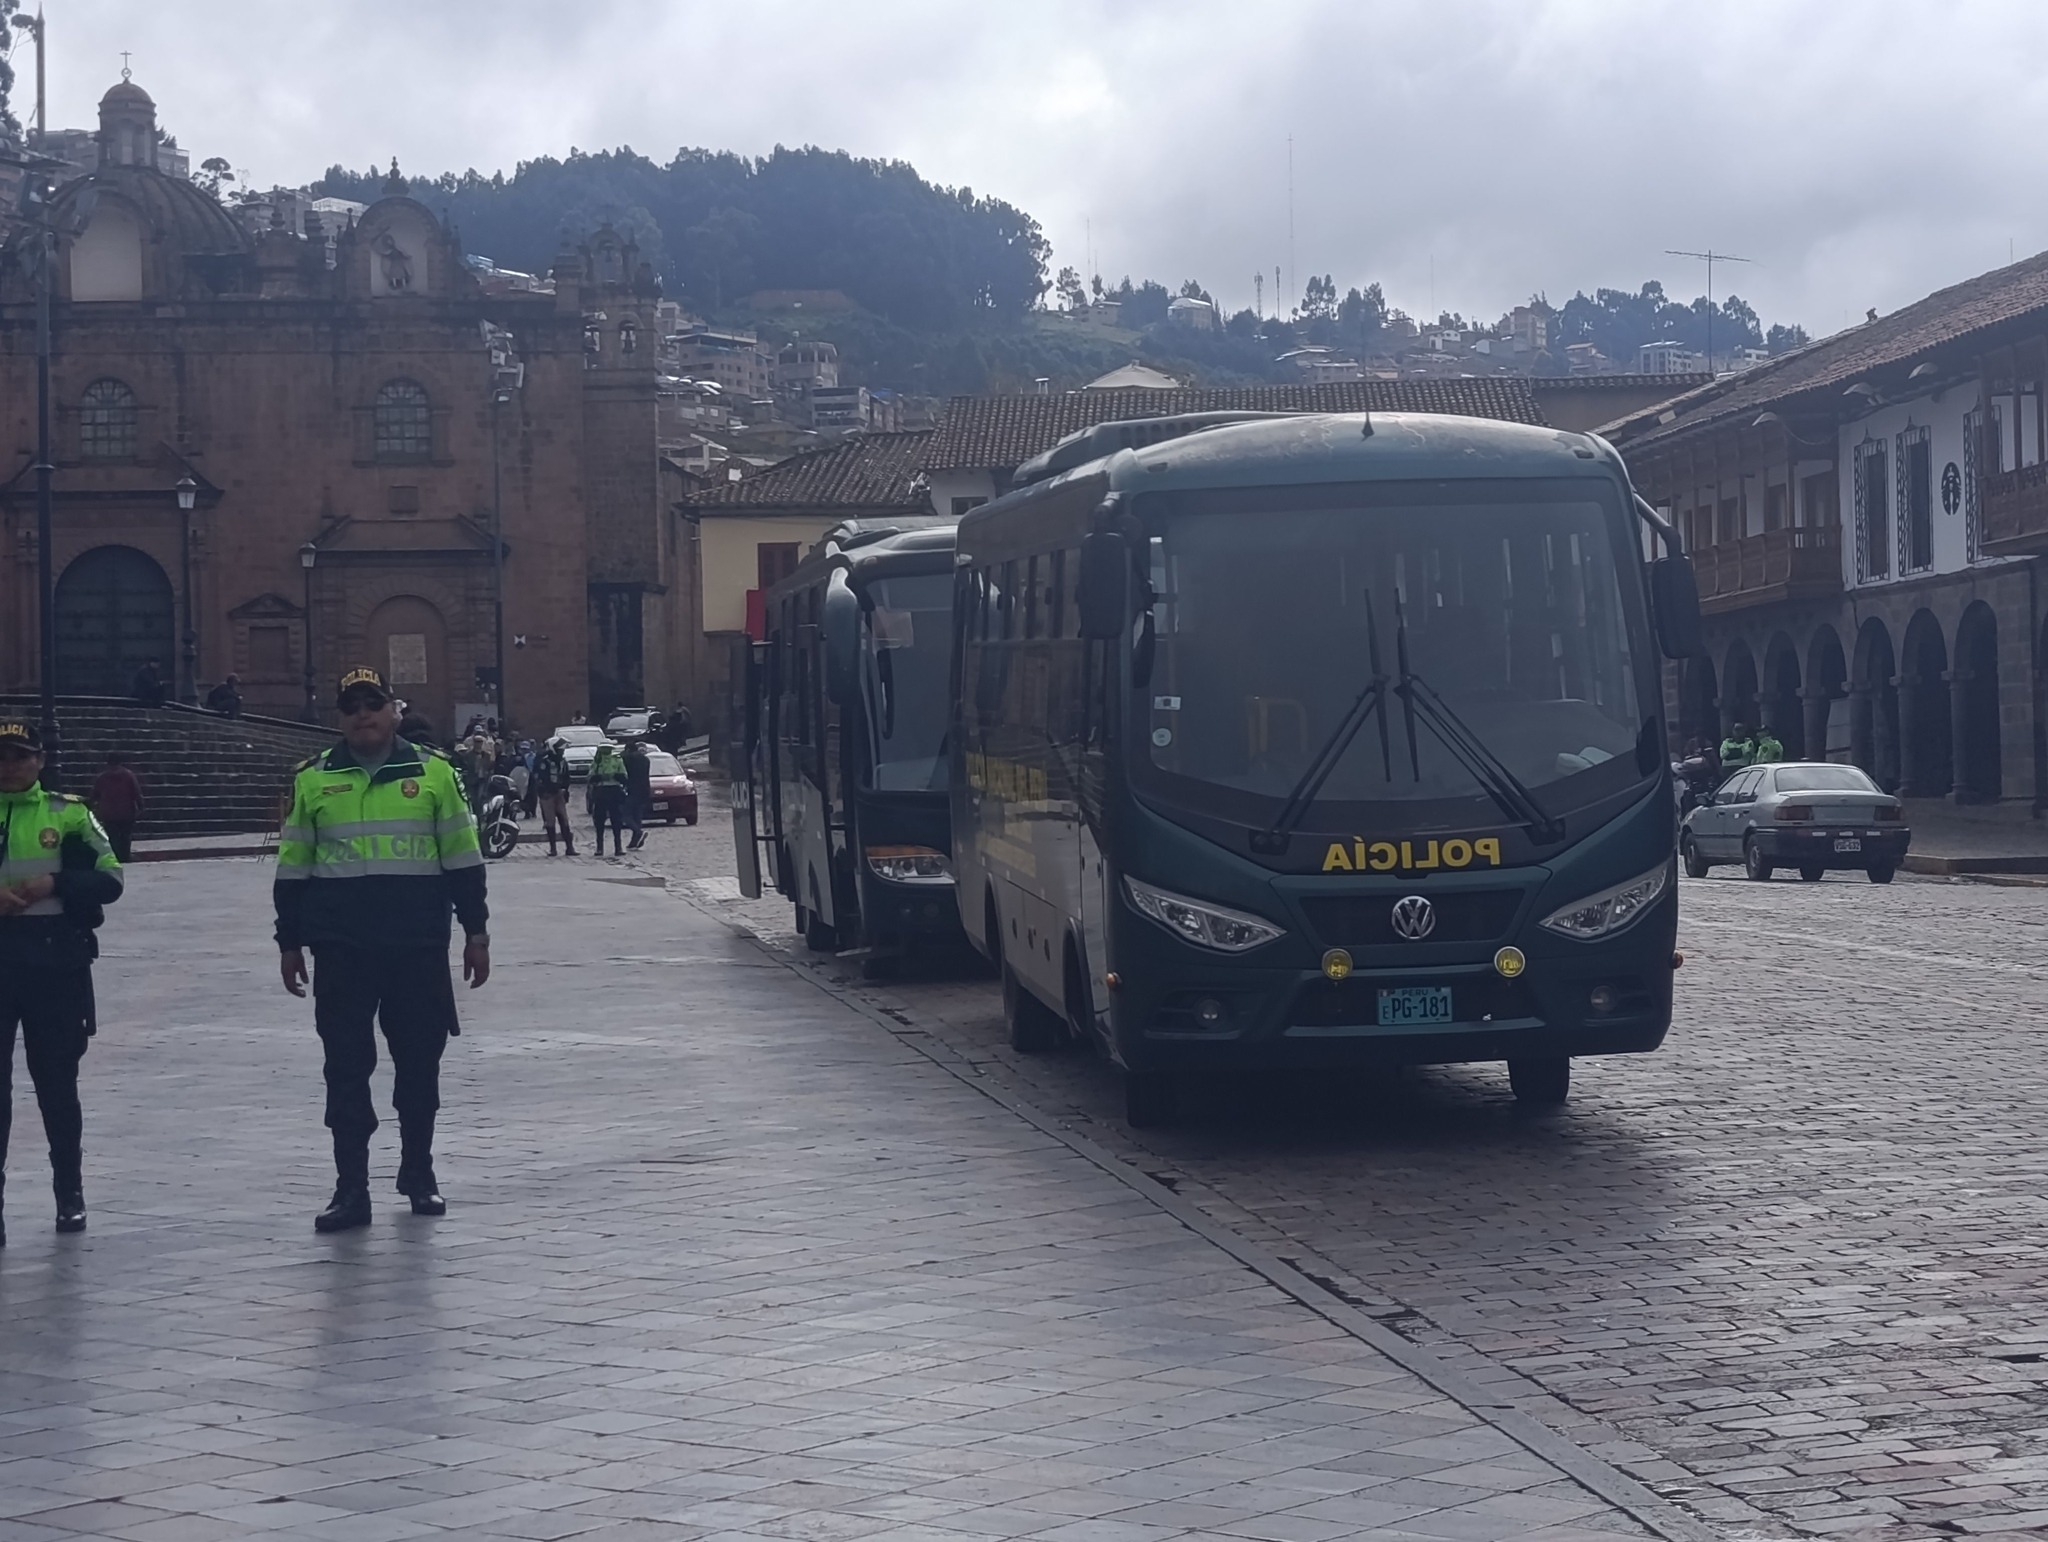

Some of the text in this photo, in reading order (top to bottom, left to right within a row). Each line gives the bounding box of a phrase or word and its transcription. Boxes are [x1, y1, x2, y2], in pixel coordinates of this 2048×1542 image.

[341, 669, 382, 692] POLICIA
[0, 723, 29, 739] LICIA
[1402, 988, 1429, 996] PERU
